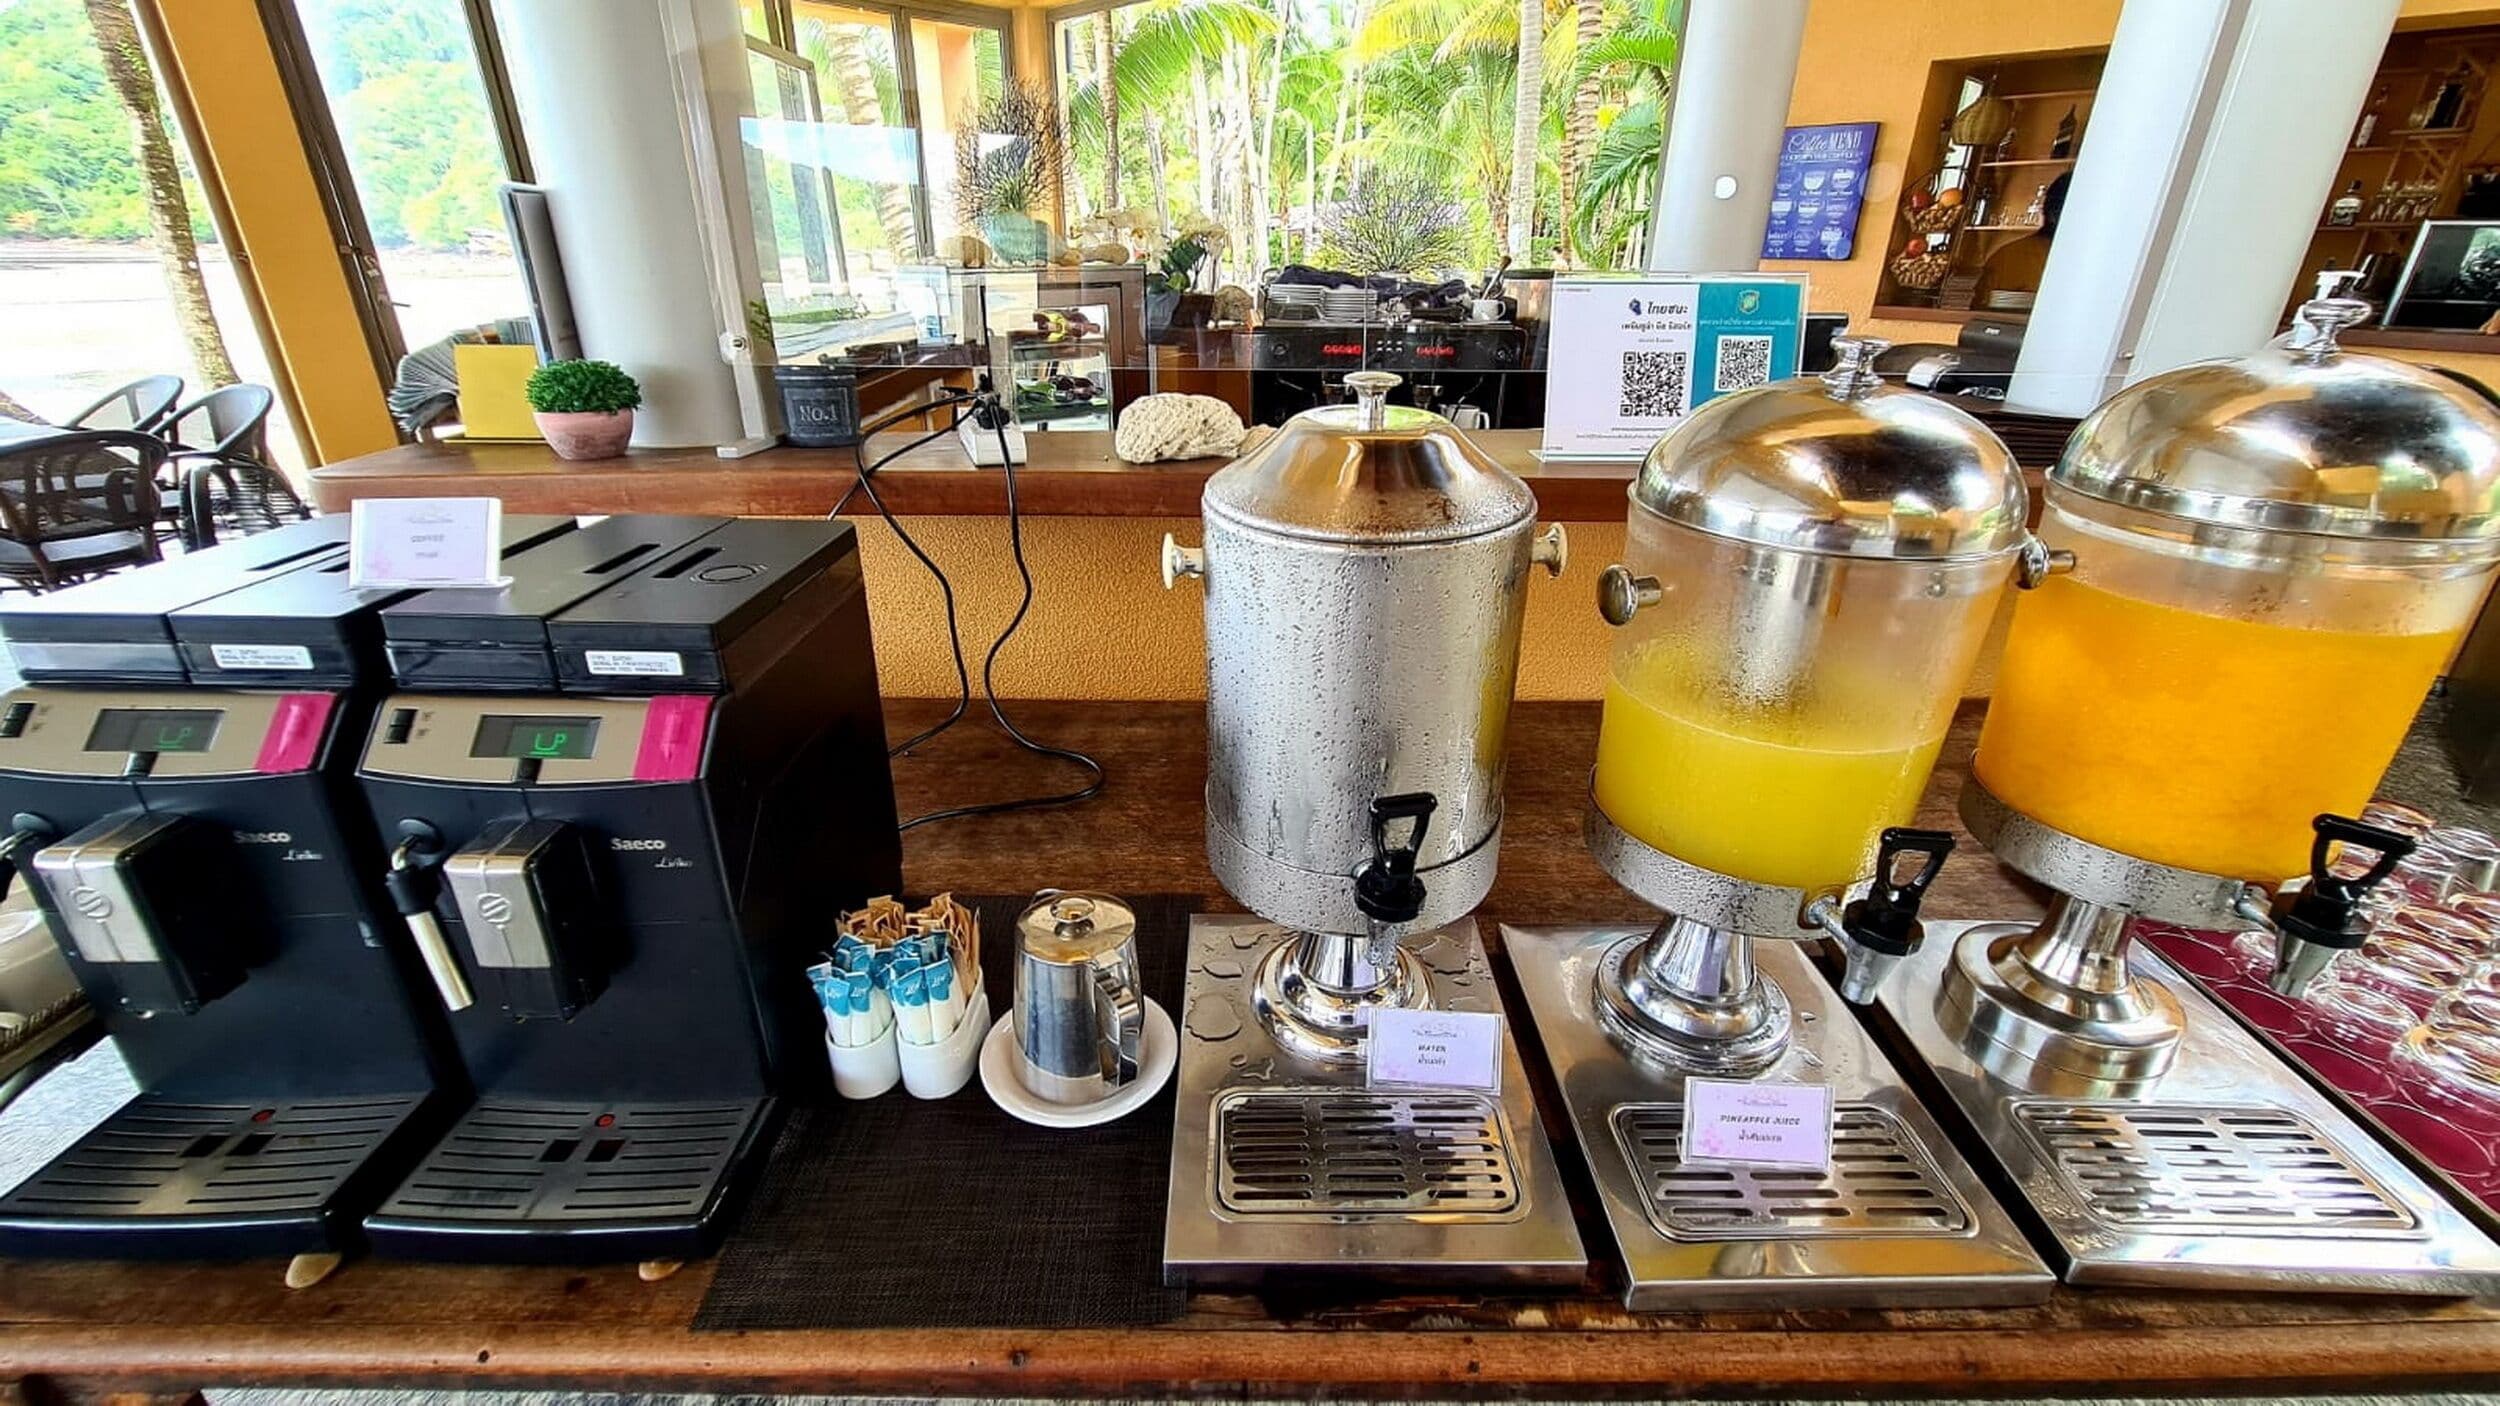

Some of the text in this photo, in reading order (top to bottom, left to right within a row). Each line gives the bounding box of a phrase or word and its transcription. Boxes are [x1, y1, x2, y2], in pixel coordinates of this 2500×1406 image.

[233, 831, 291, 843] Saeco
[611, 838, 666, 850] Saeco
[1418, 1044, 1447, 1053] WATER
[1720, 1114, 1801, 1126] PINEAPPLE JUICE
